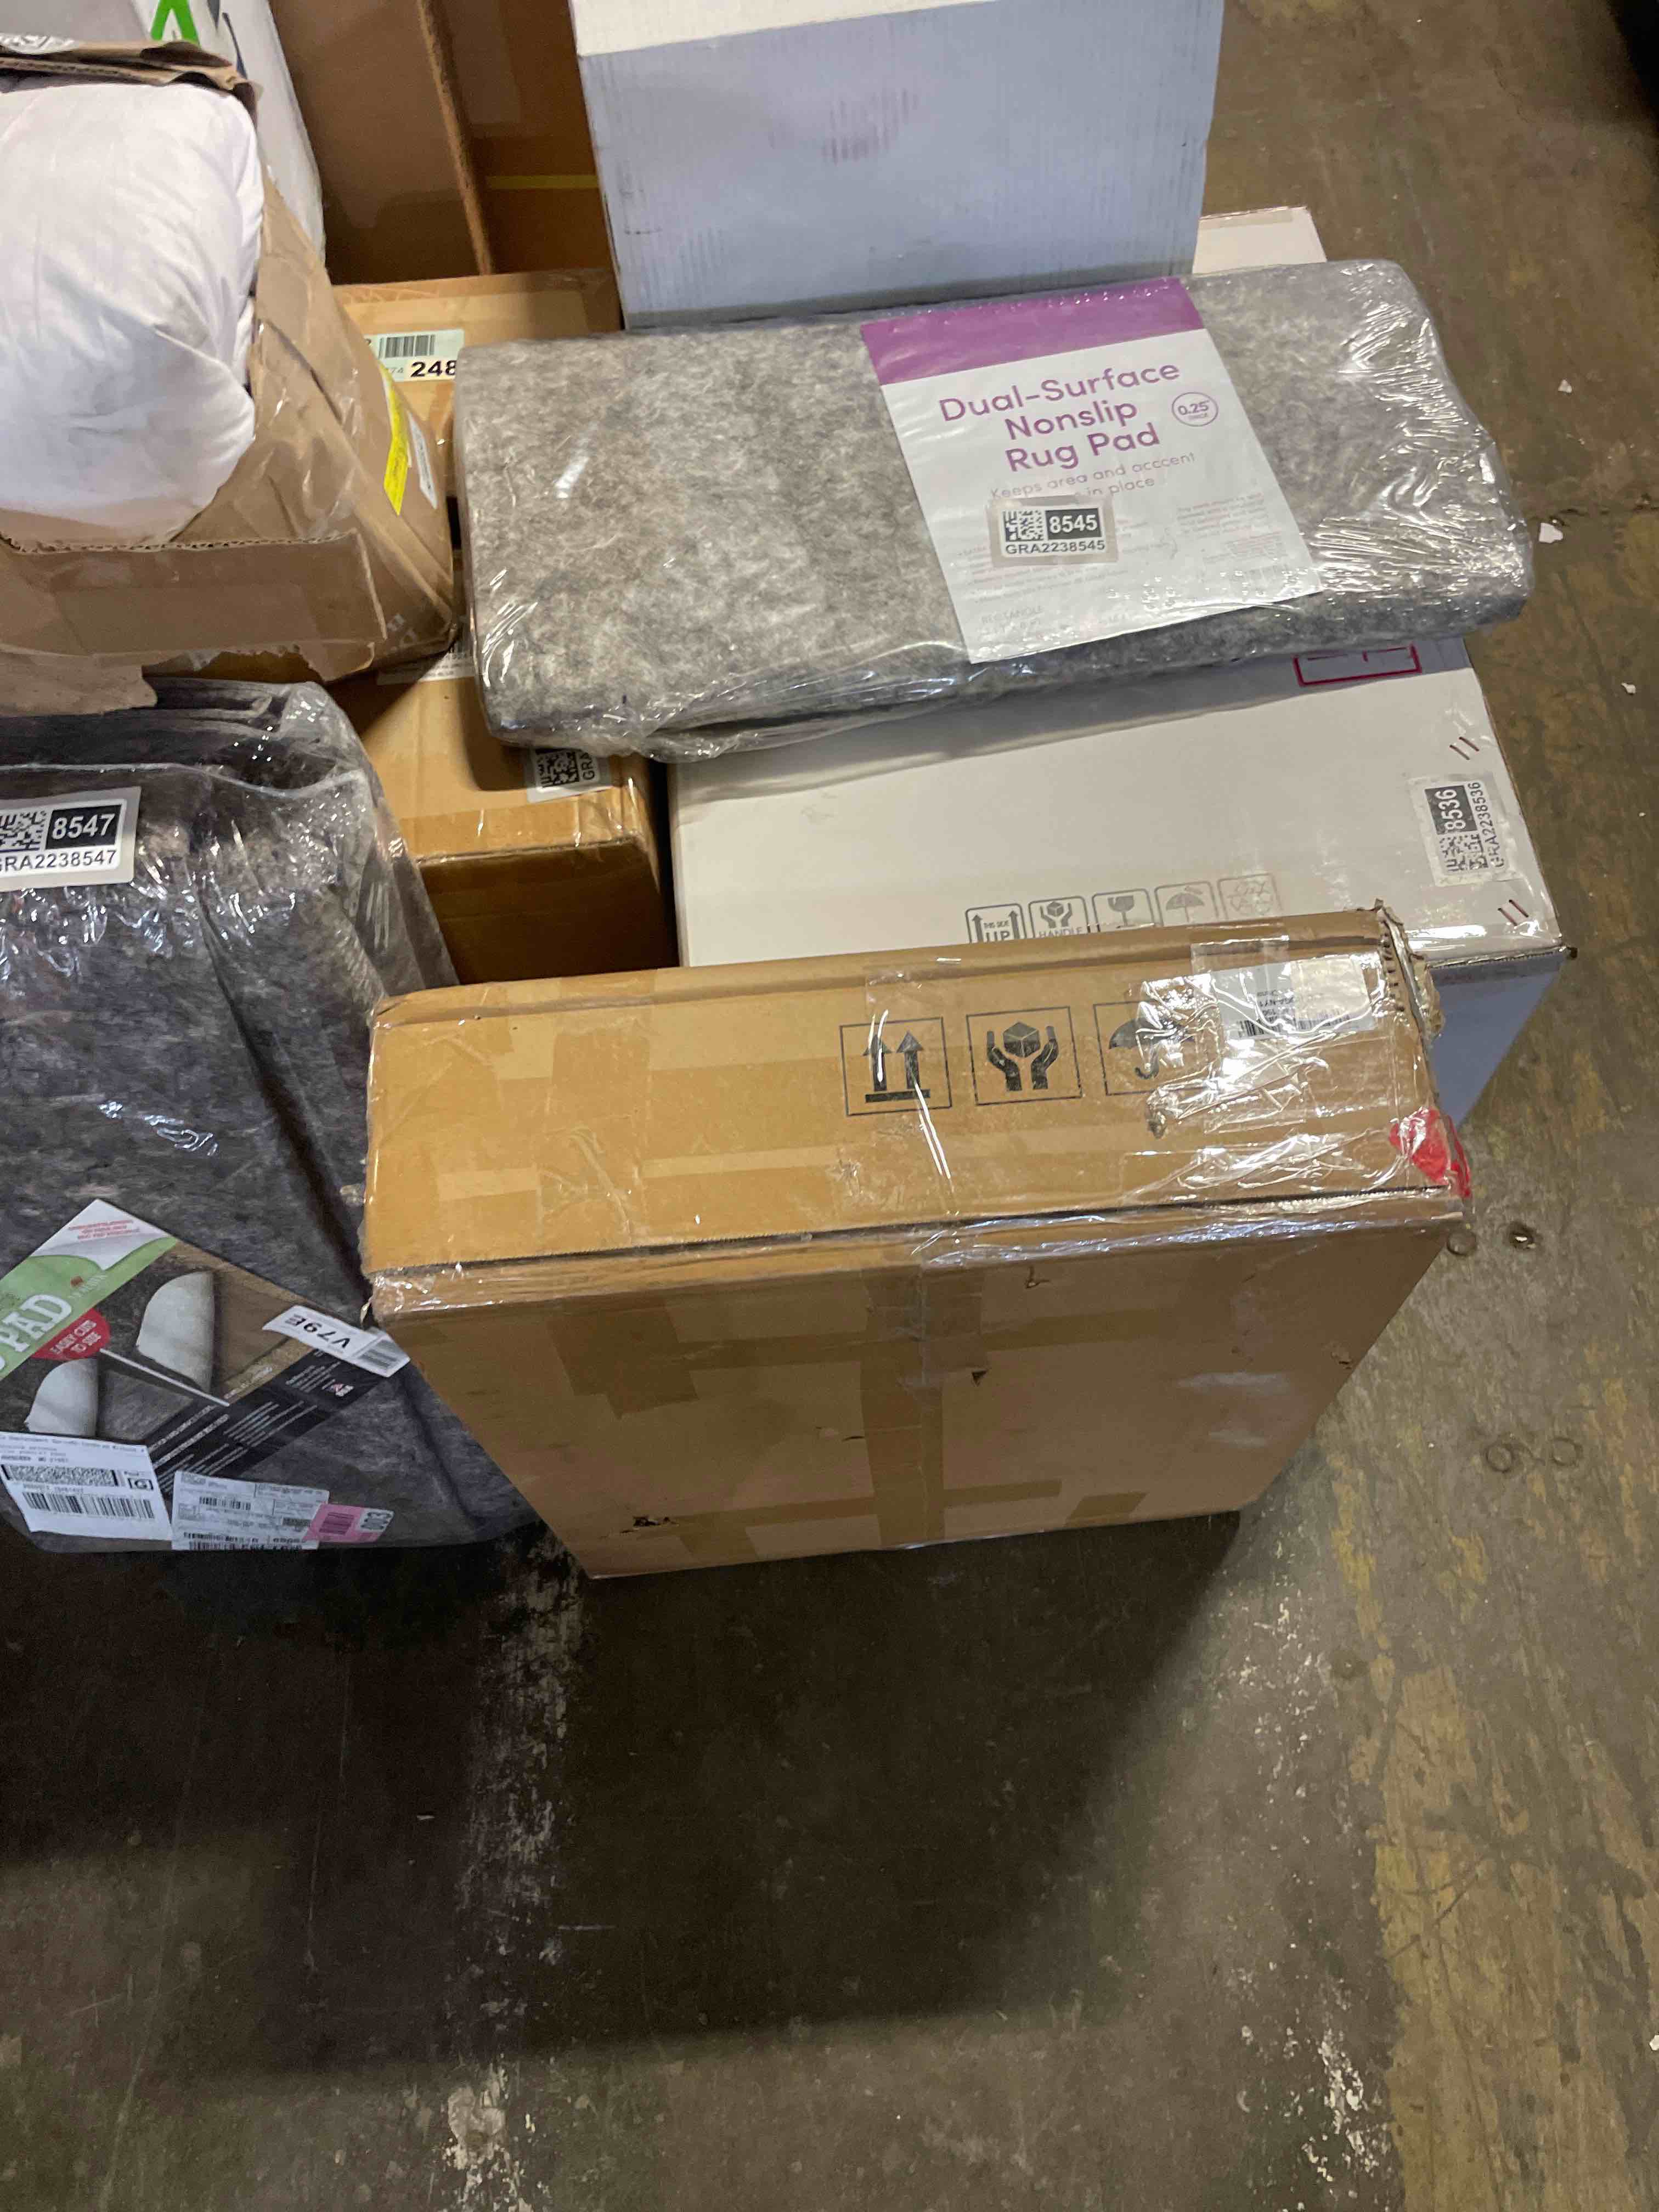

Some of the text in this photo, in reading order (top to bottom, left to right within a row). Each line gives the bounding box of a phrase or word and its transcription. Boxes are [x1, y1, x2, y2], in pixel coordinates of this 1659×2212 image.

[939, 364, 1180, 422] Dual-Surface
[1005, 399, 1138, 440] Nonslip
[1006, 422, 1160, 472] Rug Pad
[991, 481, 1042, 499] Keeps
[1047, 474, 1088, 489] area
[1092, 464, 1127, 481] and
[1108, 477, 1155, 499] place
[1048, 514, 1098, 533] 8545
[1005, 539, 1105, 555] GRA2238545
[52, 813, 116, 840] 8547
[1434, 788, 1466, 833] 8536
[1467, 782, 1505, 868] GRA2238536
[0, 849, 117, 873] RA2238547
[2, 1294, 72, 1353] PAD
[285, 1313, 351, 1350] V79E
